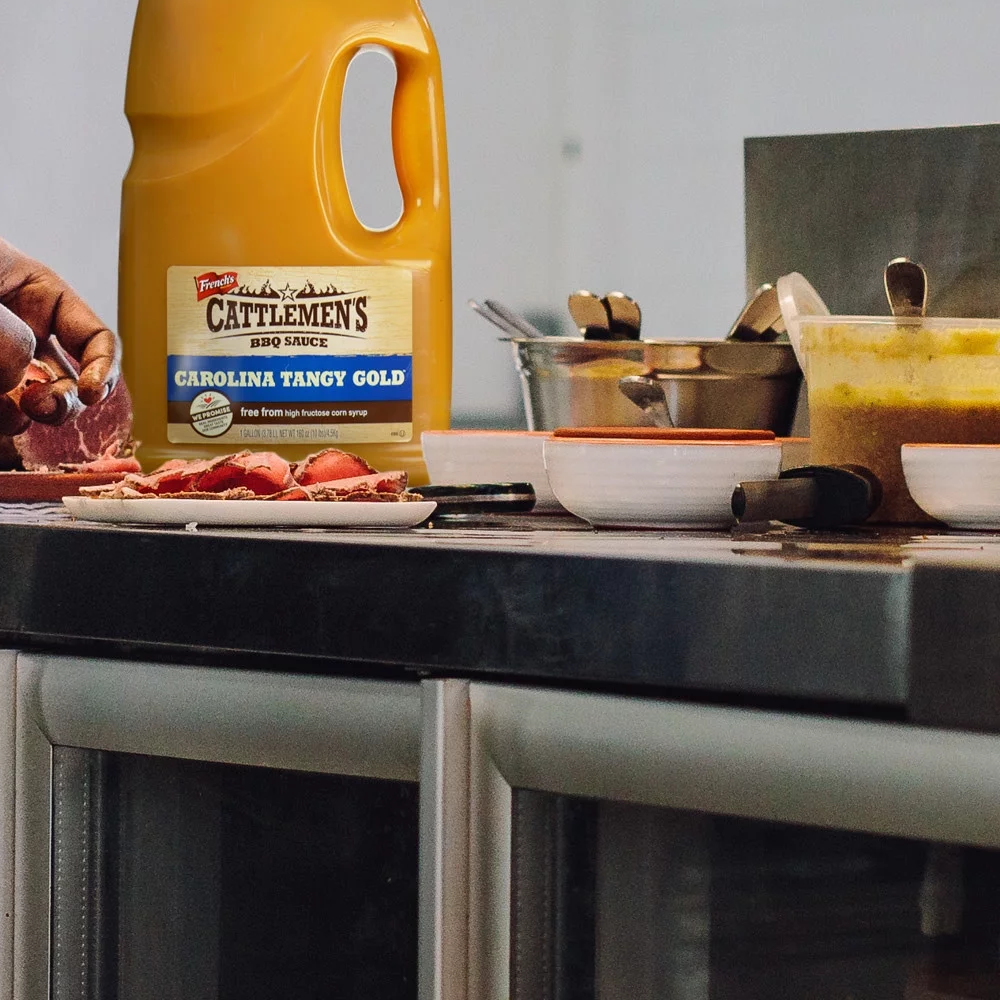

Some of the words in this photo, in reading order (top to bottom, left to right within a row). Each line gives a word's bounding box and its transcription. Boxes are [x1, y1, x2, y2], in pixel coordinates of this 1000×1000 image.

[200, 275, 235, 292] French's
[206, 296, 368, 333] CATTLEMEN'S
[250, 337, 281, 349] BBQ
[284, 336, 328, 348] SAUCE
[174, 371, 276, 387] CAROLINA
[280, 371, 347, 387] TANGY
[352, 370, 405, 386] GOLD
[202, 406, 231, 419] PROMISE
[240, 407, 259, 417] free
[261, 407, 283, 417] from
[284, 409, 300, 418] high
[301, 409, 330, 417] fructose
[348, 410, 368, 418] syrup
